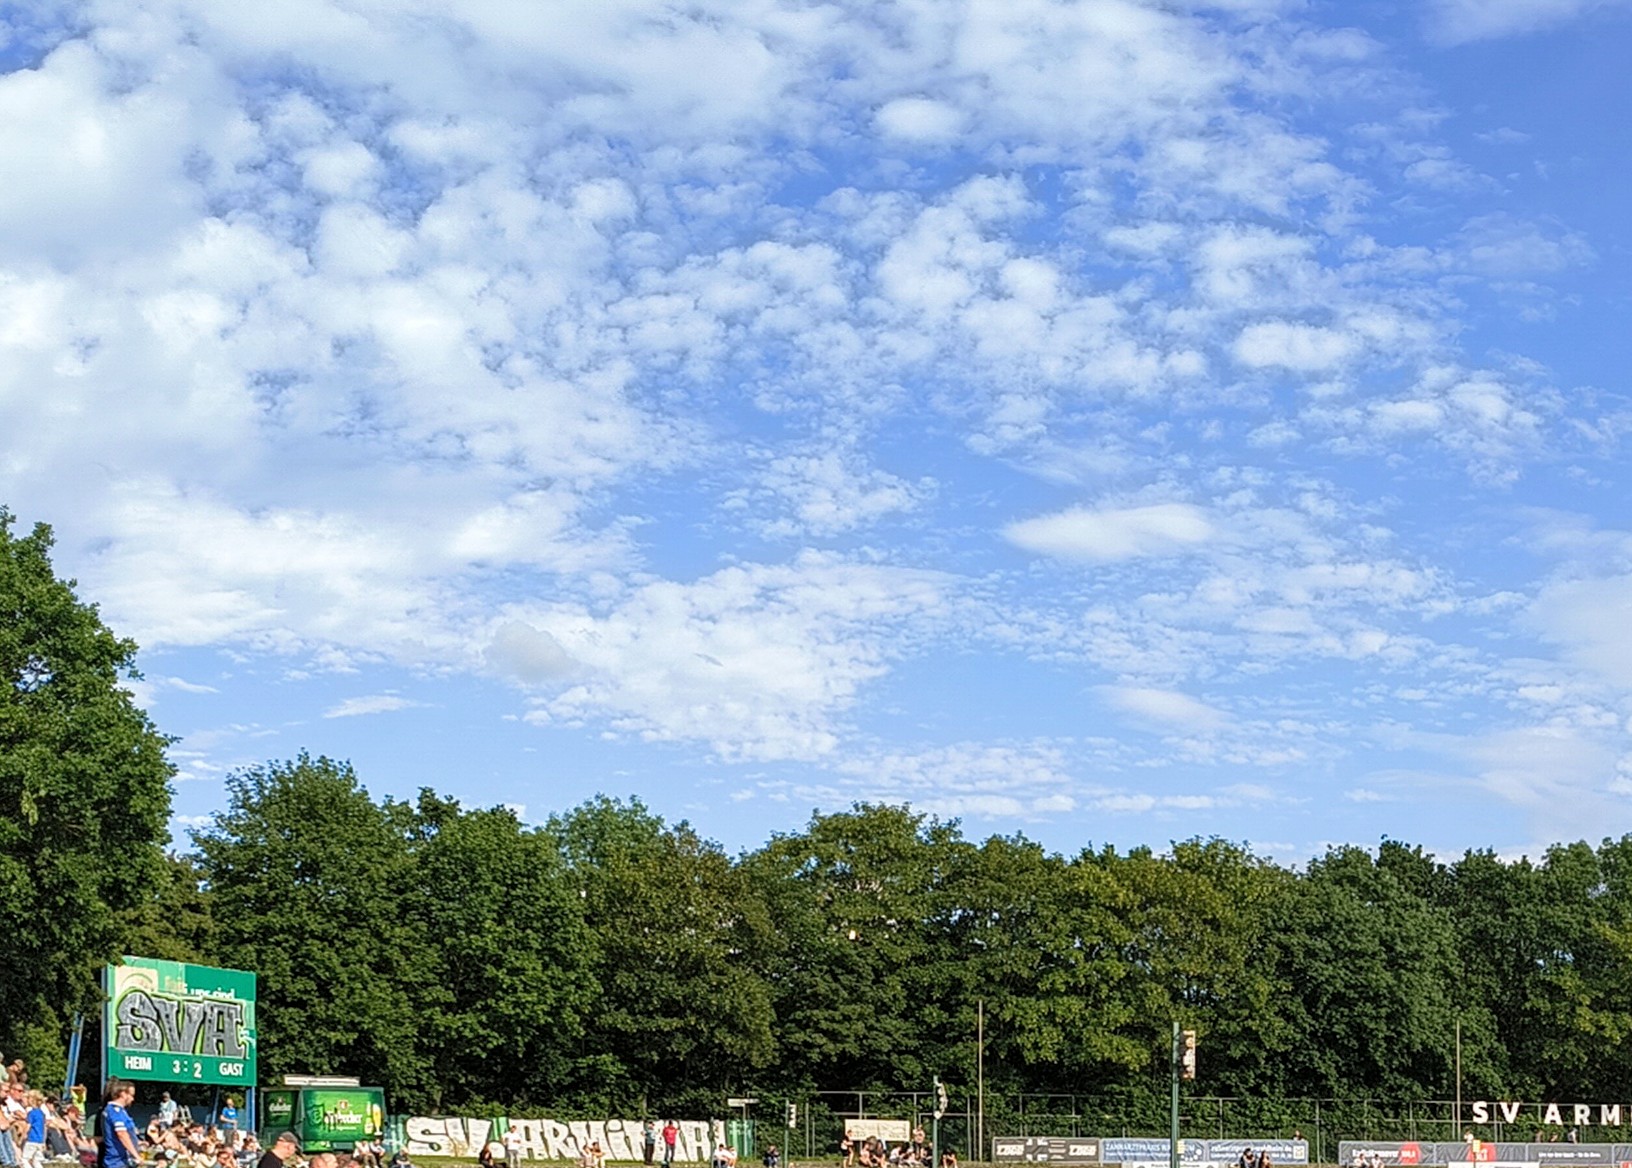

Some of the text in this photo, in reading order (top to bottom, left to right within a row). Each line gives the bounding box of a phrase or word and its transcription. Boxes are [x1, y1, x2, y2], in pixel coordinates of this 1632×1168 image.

[116, 989, 249, 1059] SVA
[124, 1056, 153, 1071] HEIM
[172, 1060, 181, 1074] 3
[193, 1063, 203, 1078] 2
[218, 1062, 245, 1077] GAST
[1471, 1099, 1521, 1125] SV
